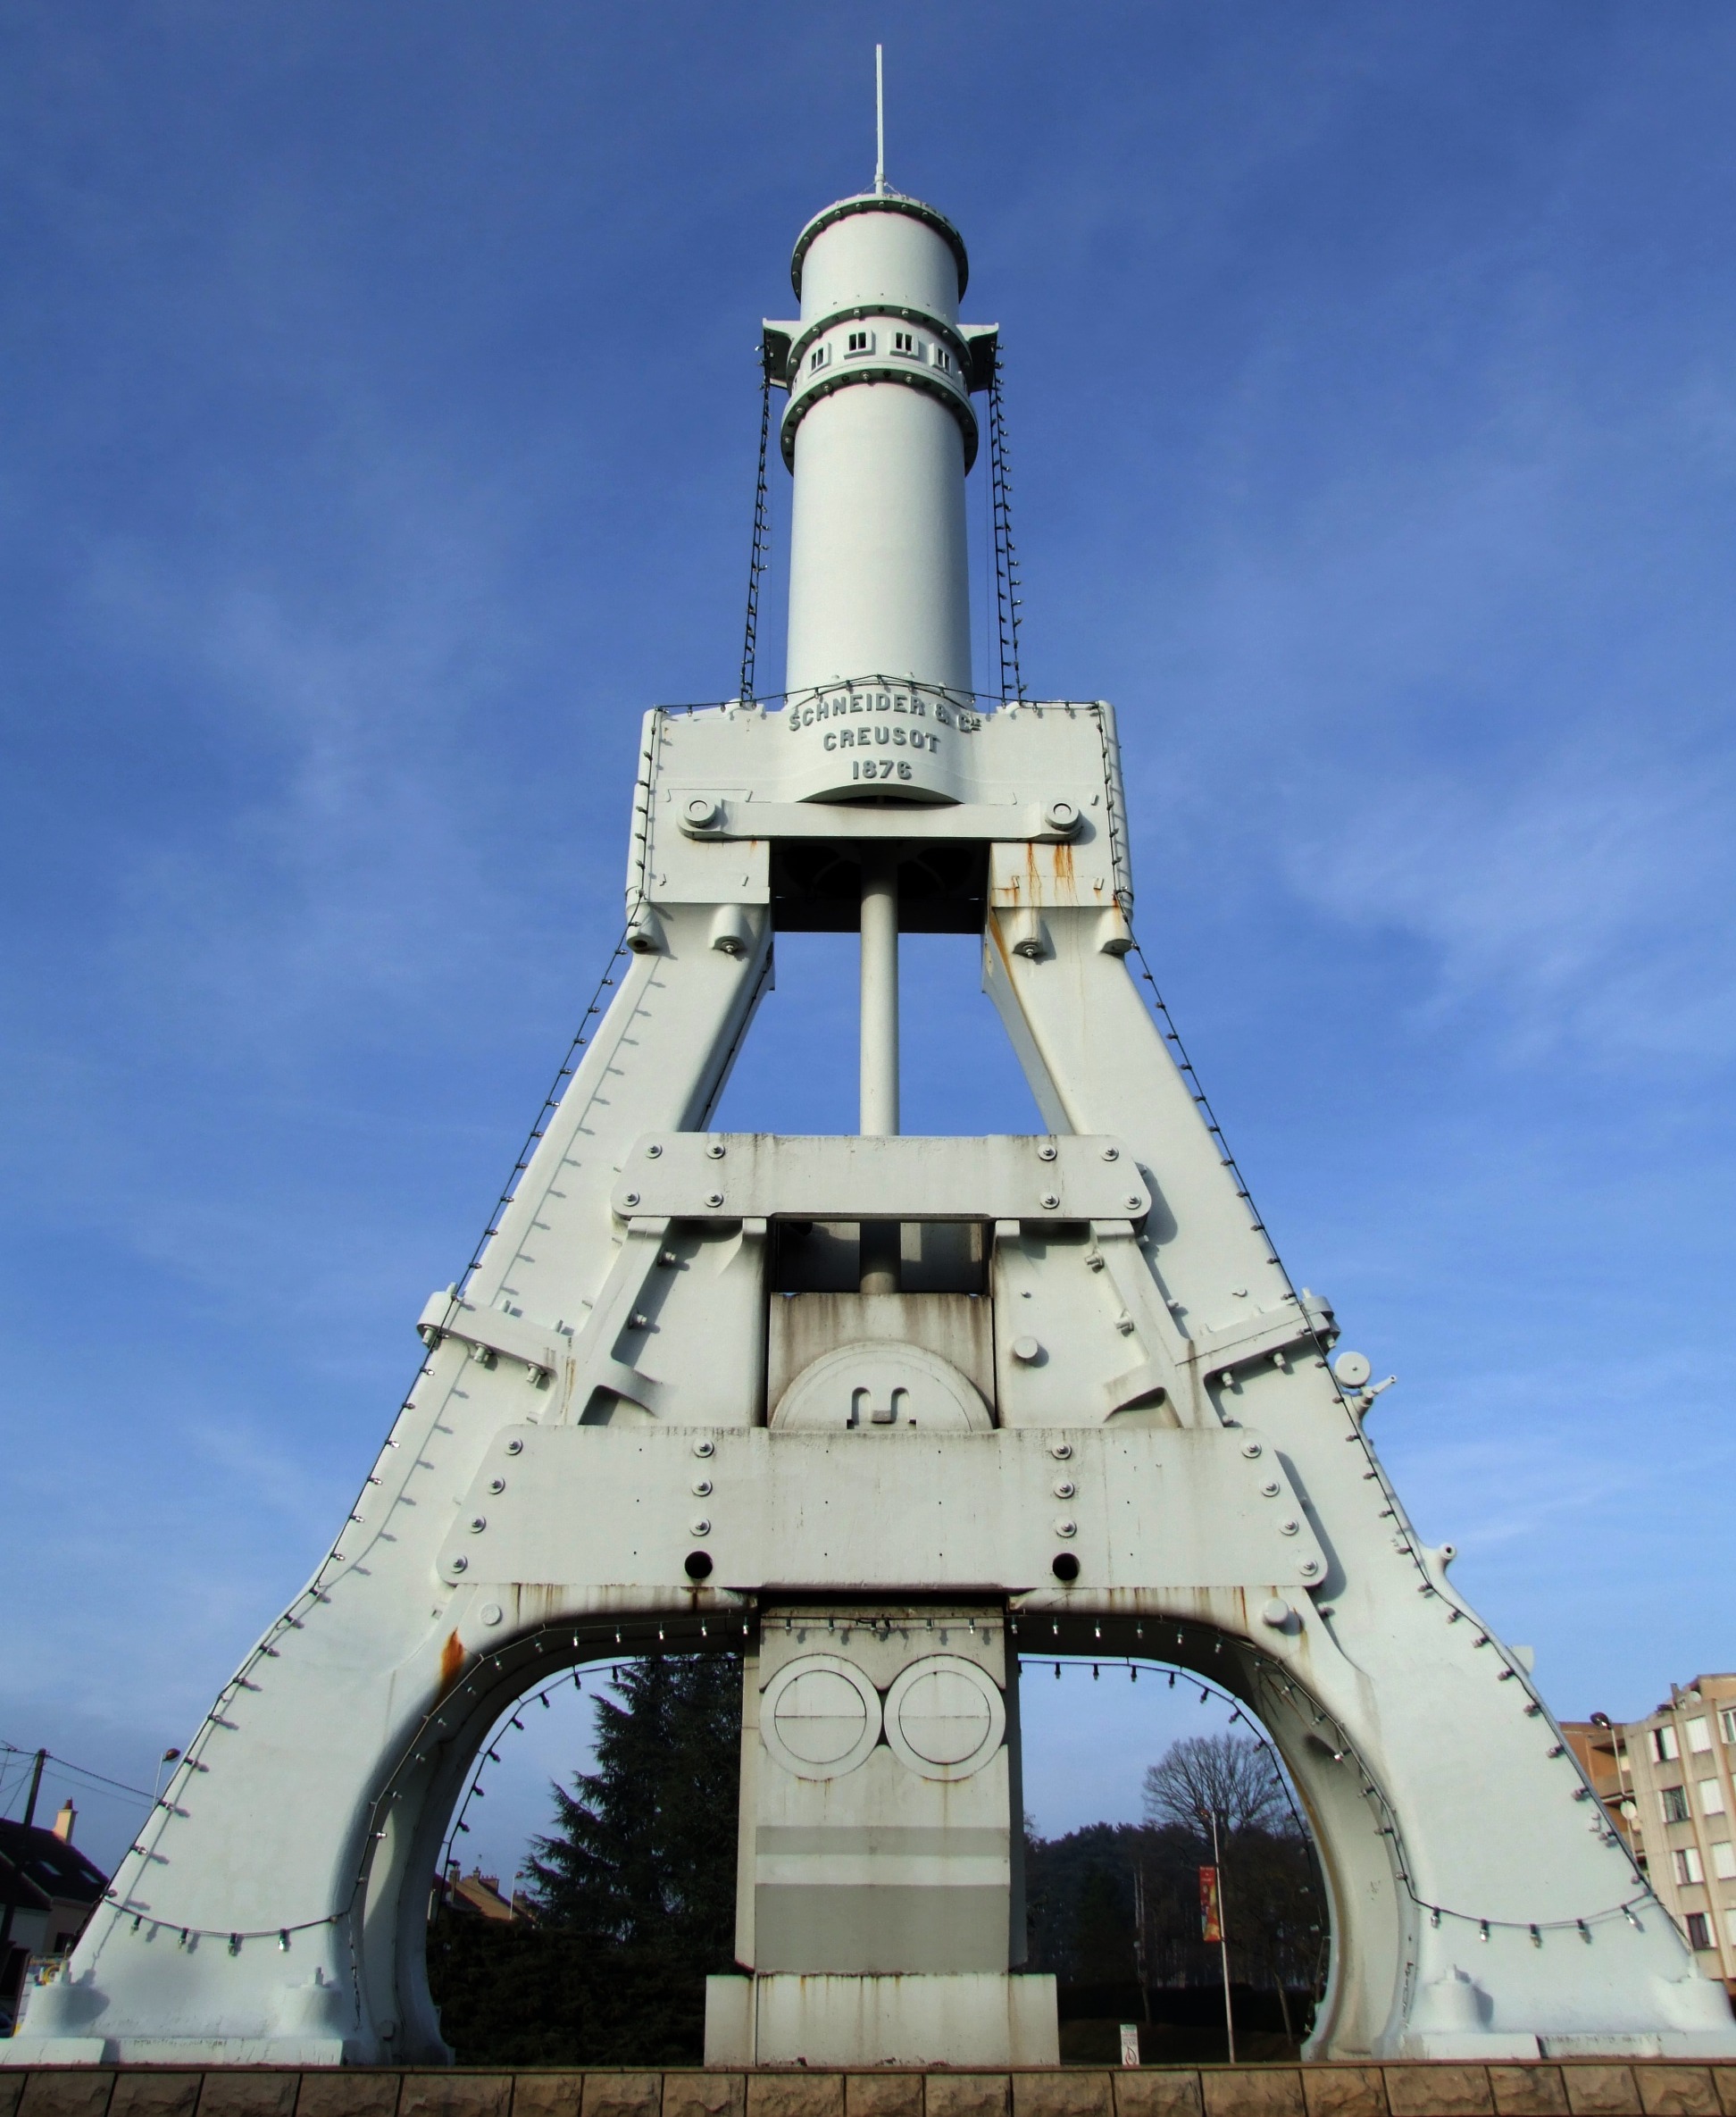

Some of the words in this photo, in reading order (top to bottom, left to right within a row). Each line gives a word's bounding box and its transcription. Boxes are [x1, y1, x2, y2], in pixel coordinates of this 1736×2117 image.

[789, 692, 925, 731] SCHNEIDER
[933, 703, 948, 725] &
[823, 726, 940, 752] CREUSOT
[852, 759, 913, 780] 1876
